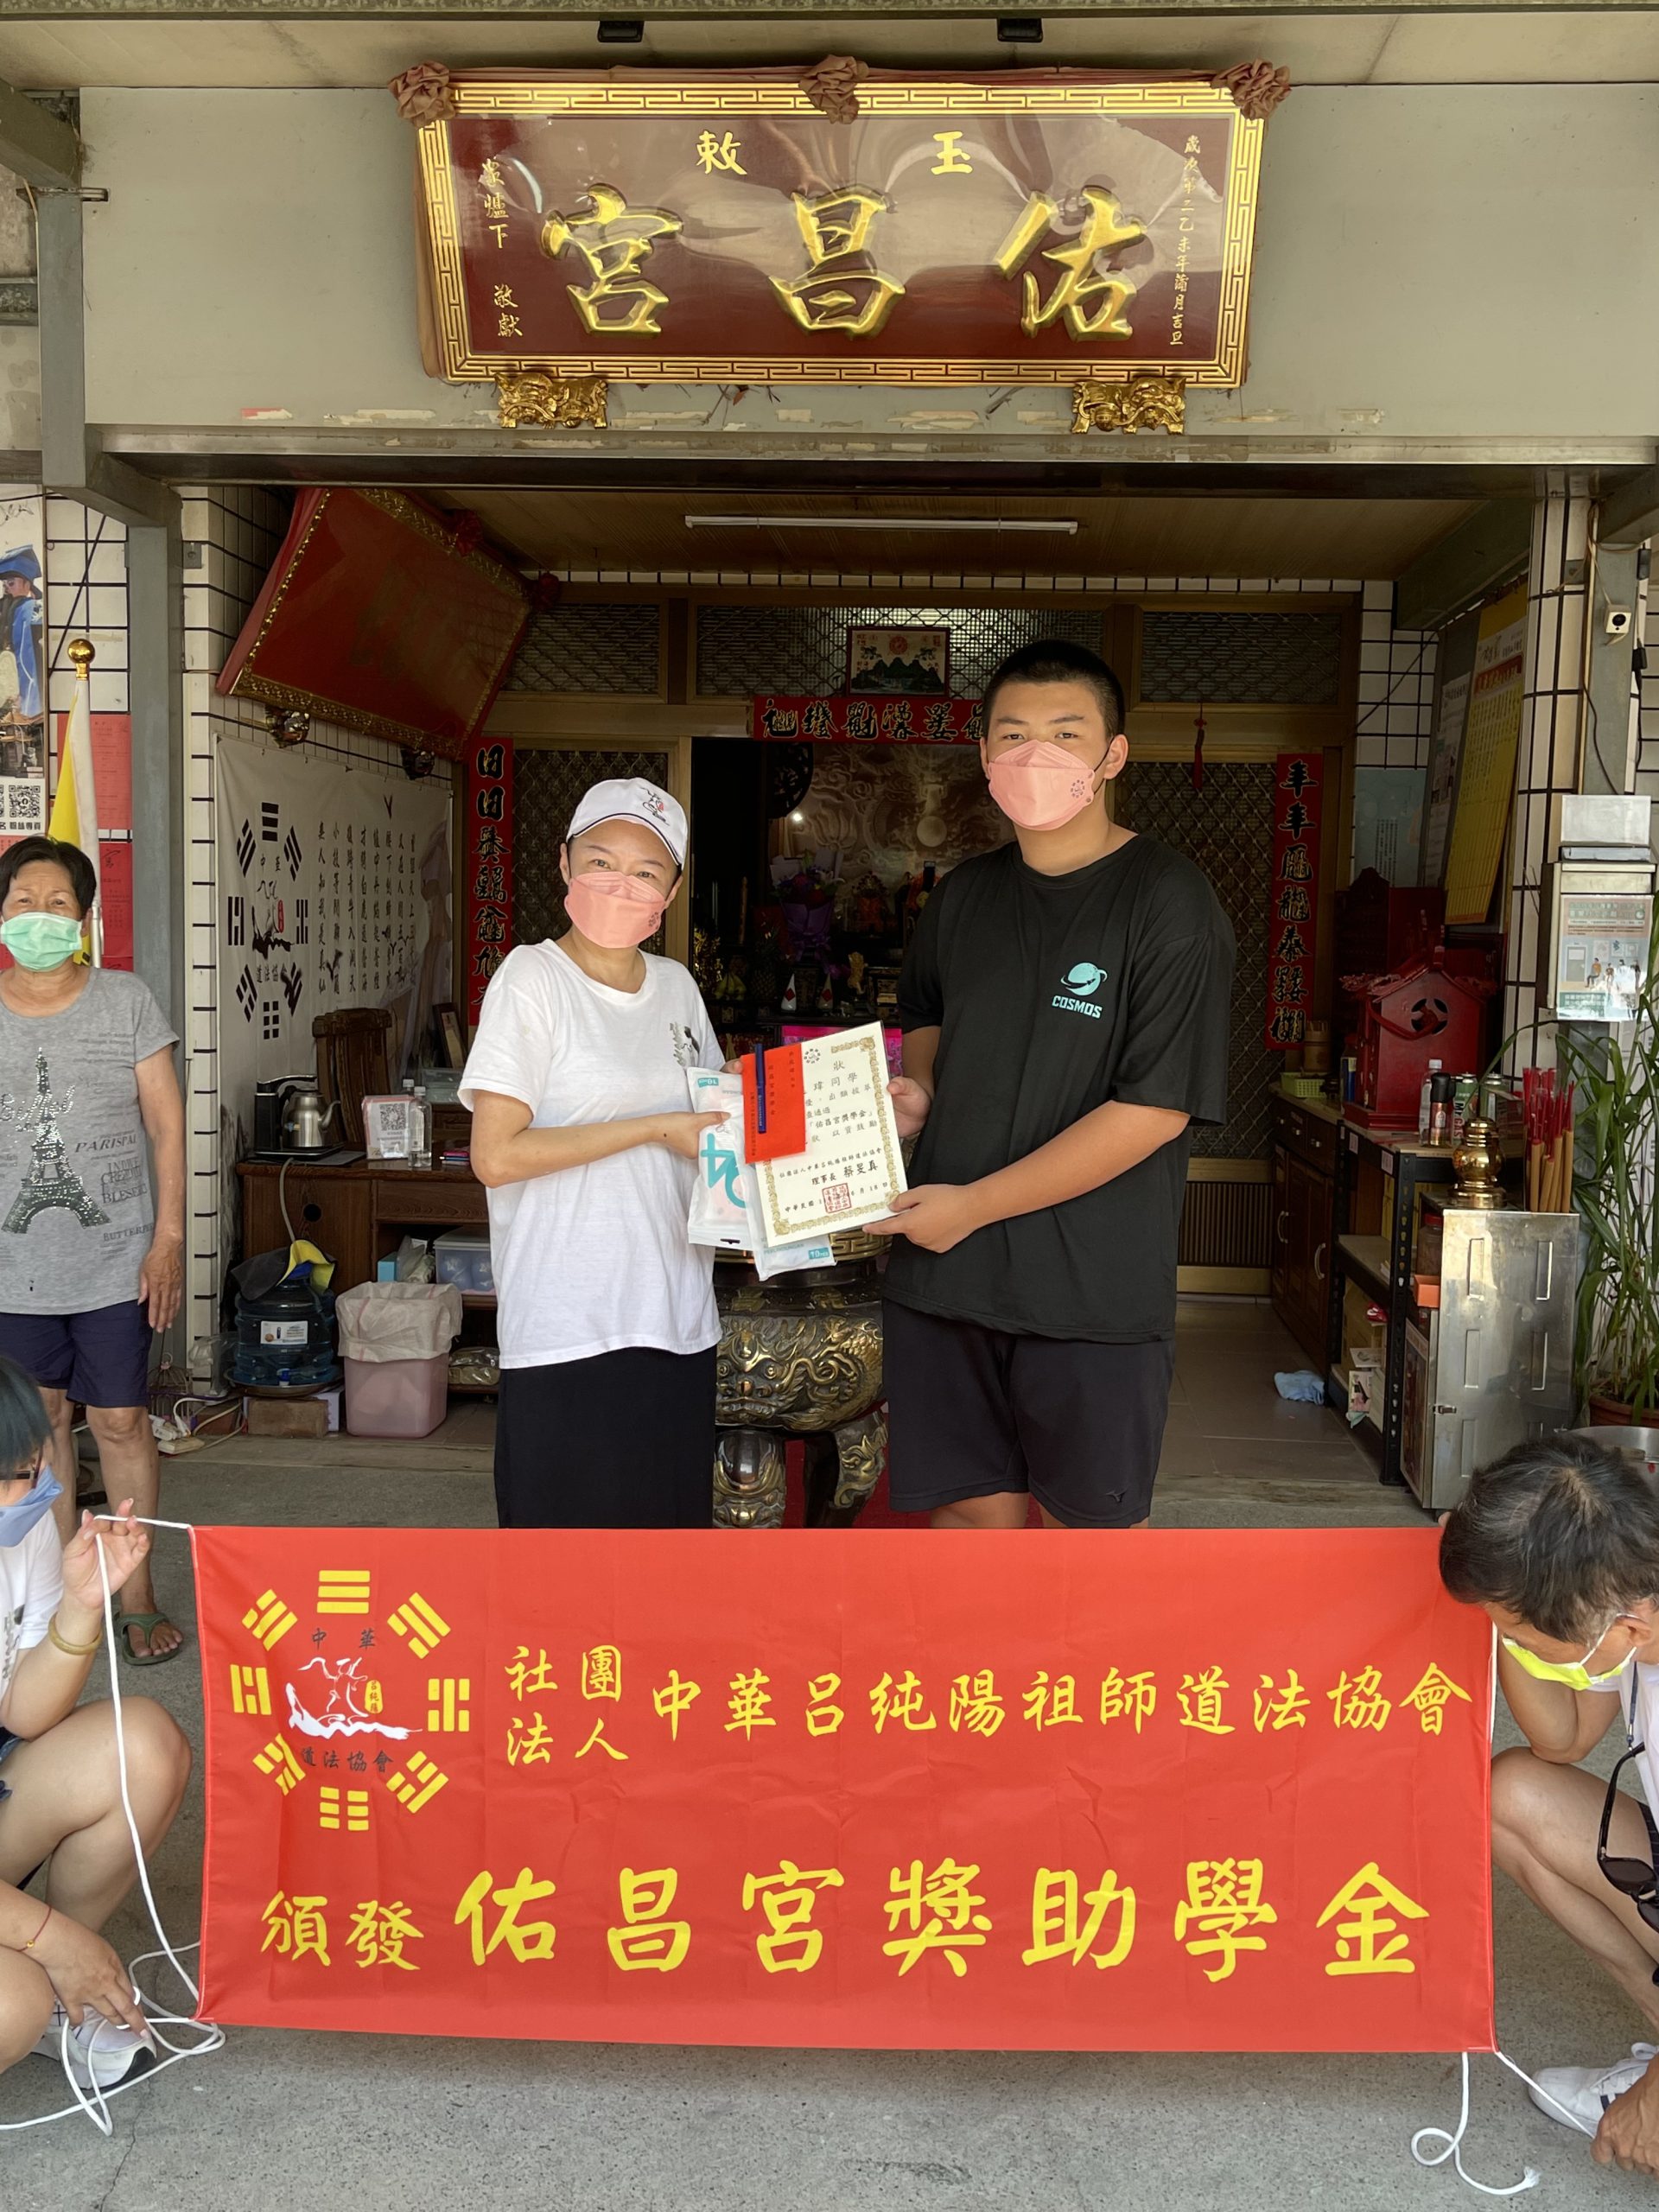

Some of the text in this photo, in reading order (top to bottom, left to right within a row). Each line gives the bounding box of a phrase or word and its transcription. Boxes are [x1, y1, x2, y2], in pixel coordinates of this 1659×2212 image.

[541, 183, 1146, 341] 佑昌宮
[1052, 995, 1103, 1019] COSMOS
[311, 1627, 377, 1649] 中華
[504, 1644, 622, 1701] 社團
[652, 1661, 1473, 1742] 中華呂純陽祖師道法協會
[300, 1745, 394, 1774] 道法協會
[506, 1710, 629, 1765] 法人
[454, 1857, 1430, 1982] 佑昌宮獎助學金
